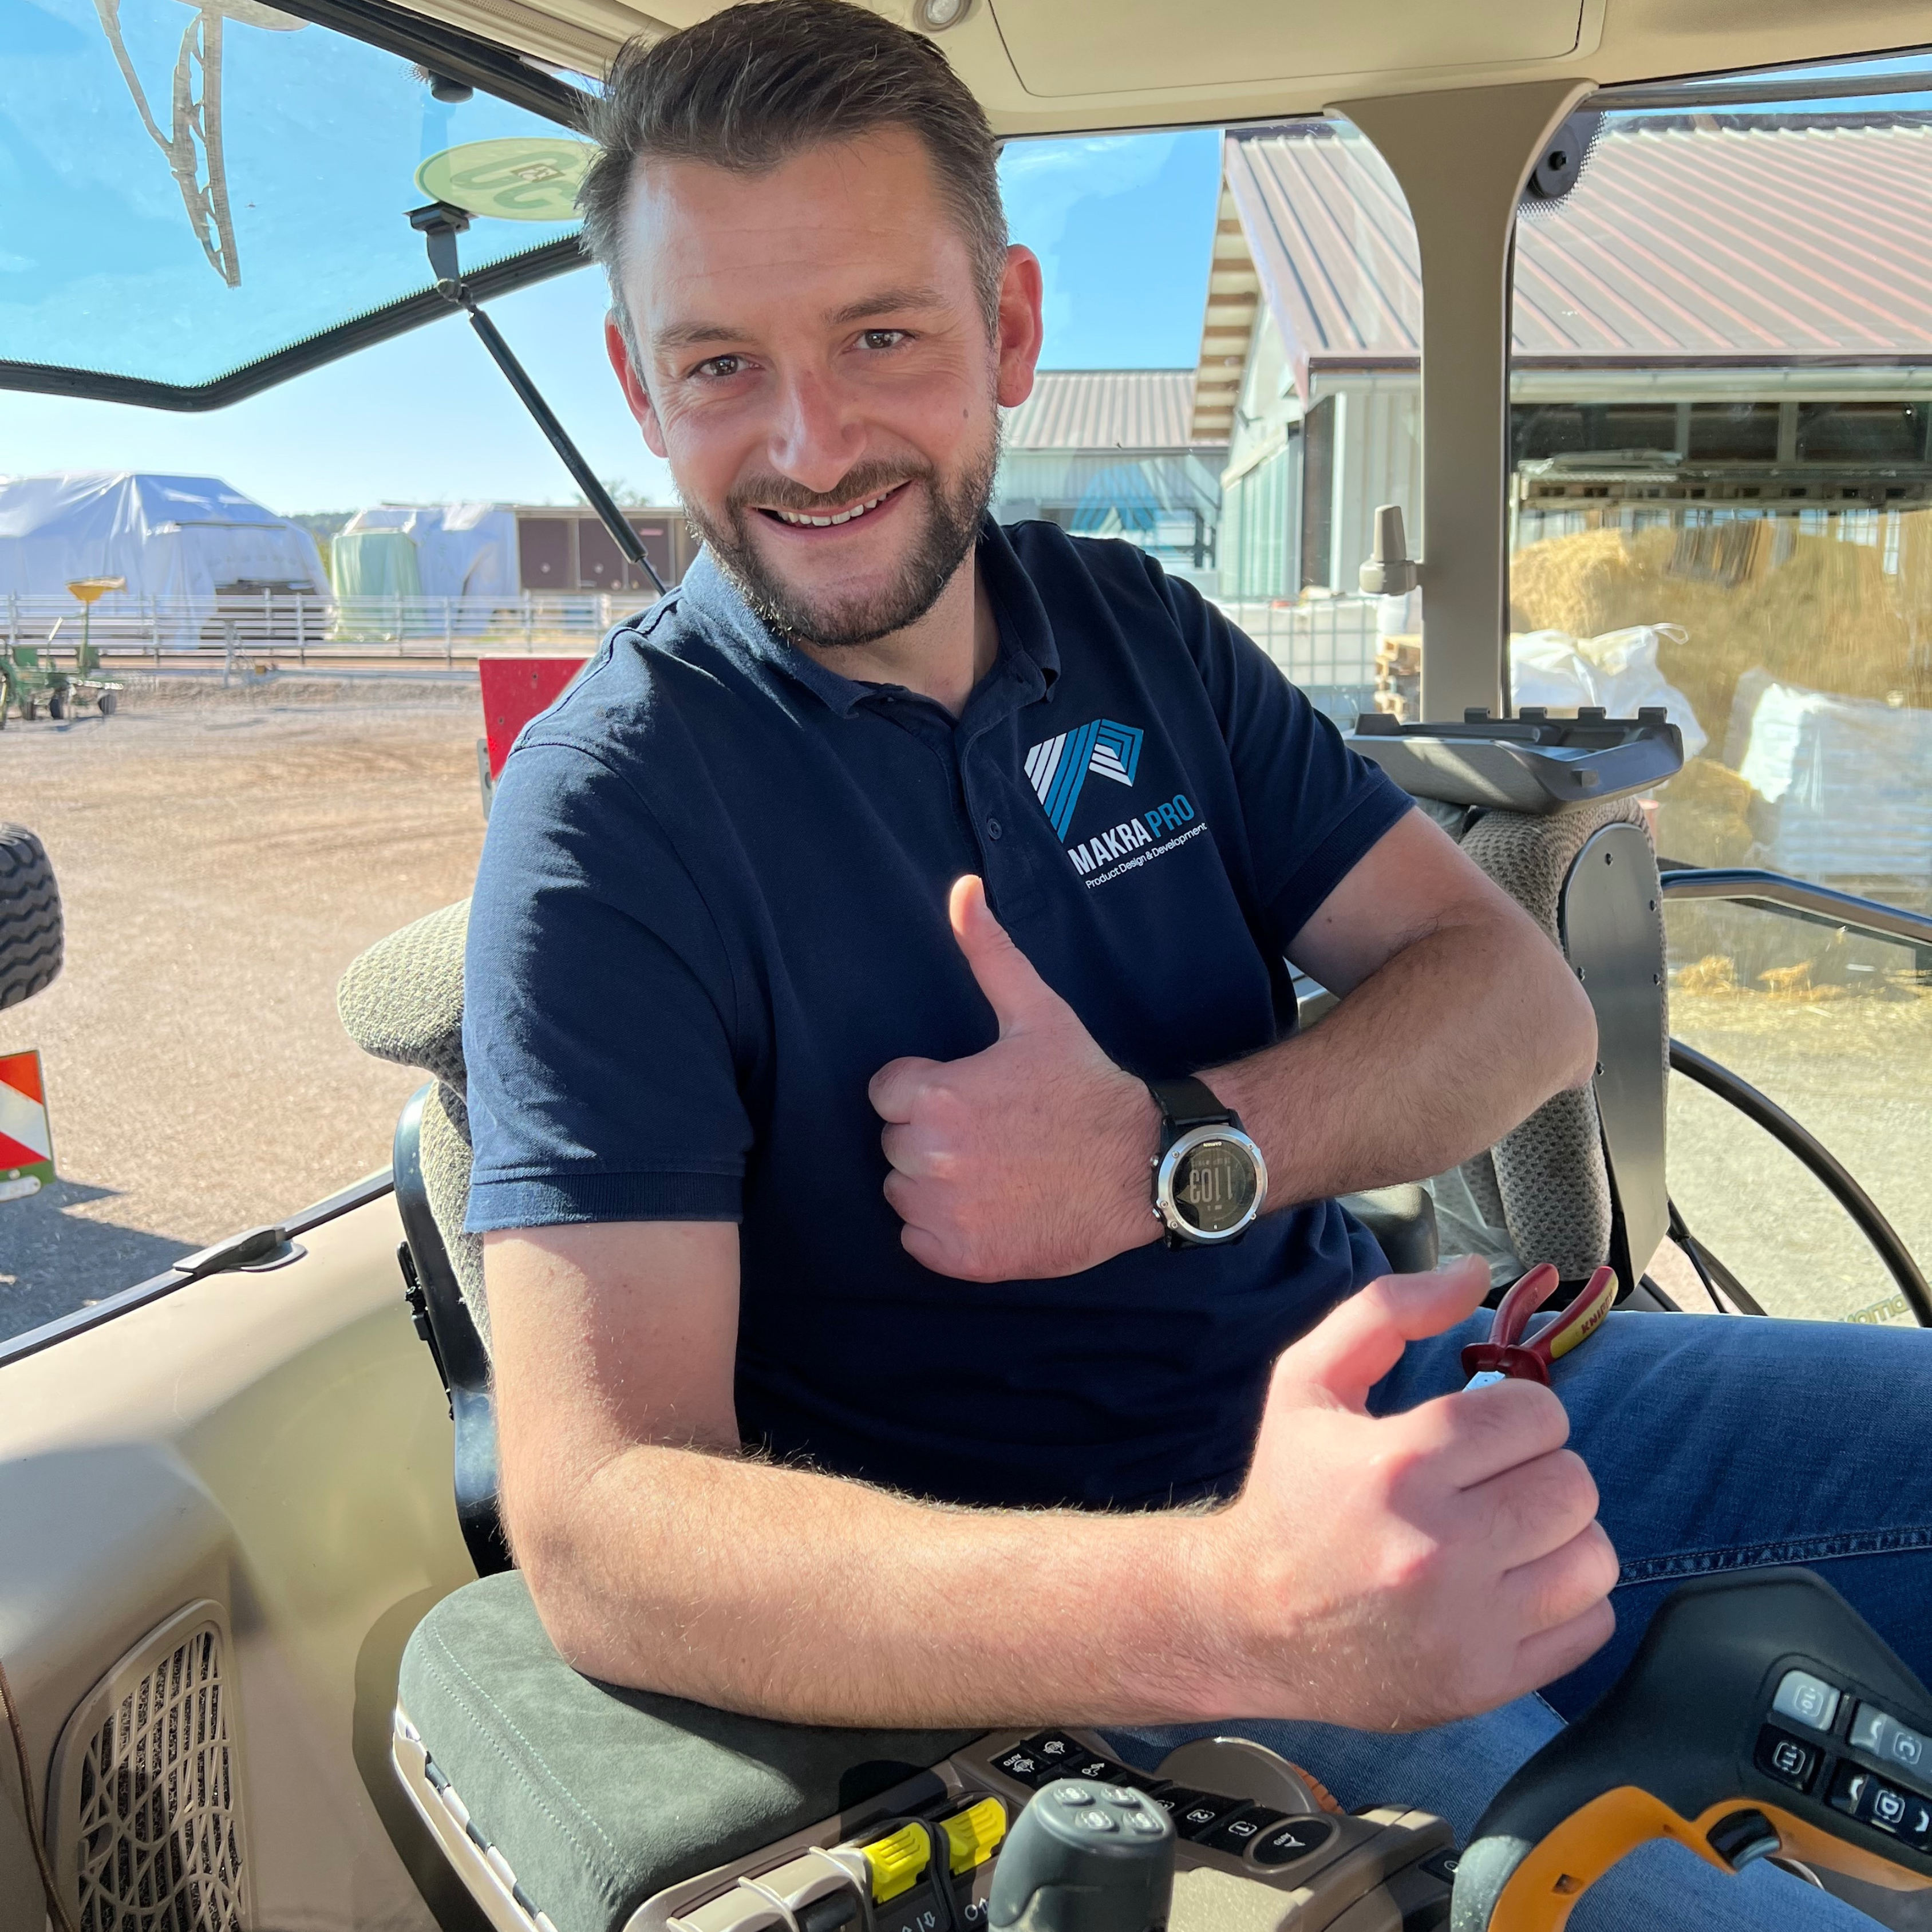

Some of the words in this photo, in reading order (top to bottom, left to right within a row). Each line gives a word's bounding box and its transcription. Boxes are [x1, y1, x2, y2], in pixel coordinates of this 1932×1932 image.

[1068, 818, 1153, 875] MAKRA
[1144, 795, 1194, 838] PRO
[1085, 867, 1121, 888] Product
[1119, 855, 1147, 873] Design
[1145, 851, 1153, 860] &
[1151, 822, 1207, 858] Development
[1003, 1753, 1021, 1766] AUTO
[1193, 1811, 1208, 1820] 2
[1273, 1832, 1291, 1846] AUTO
